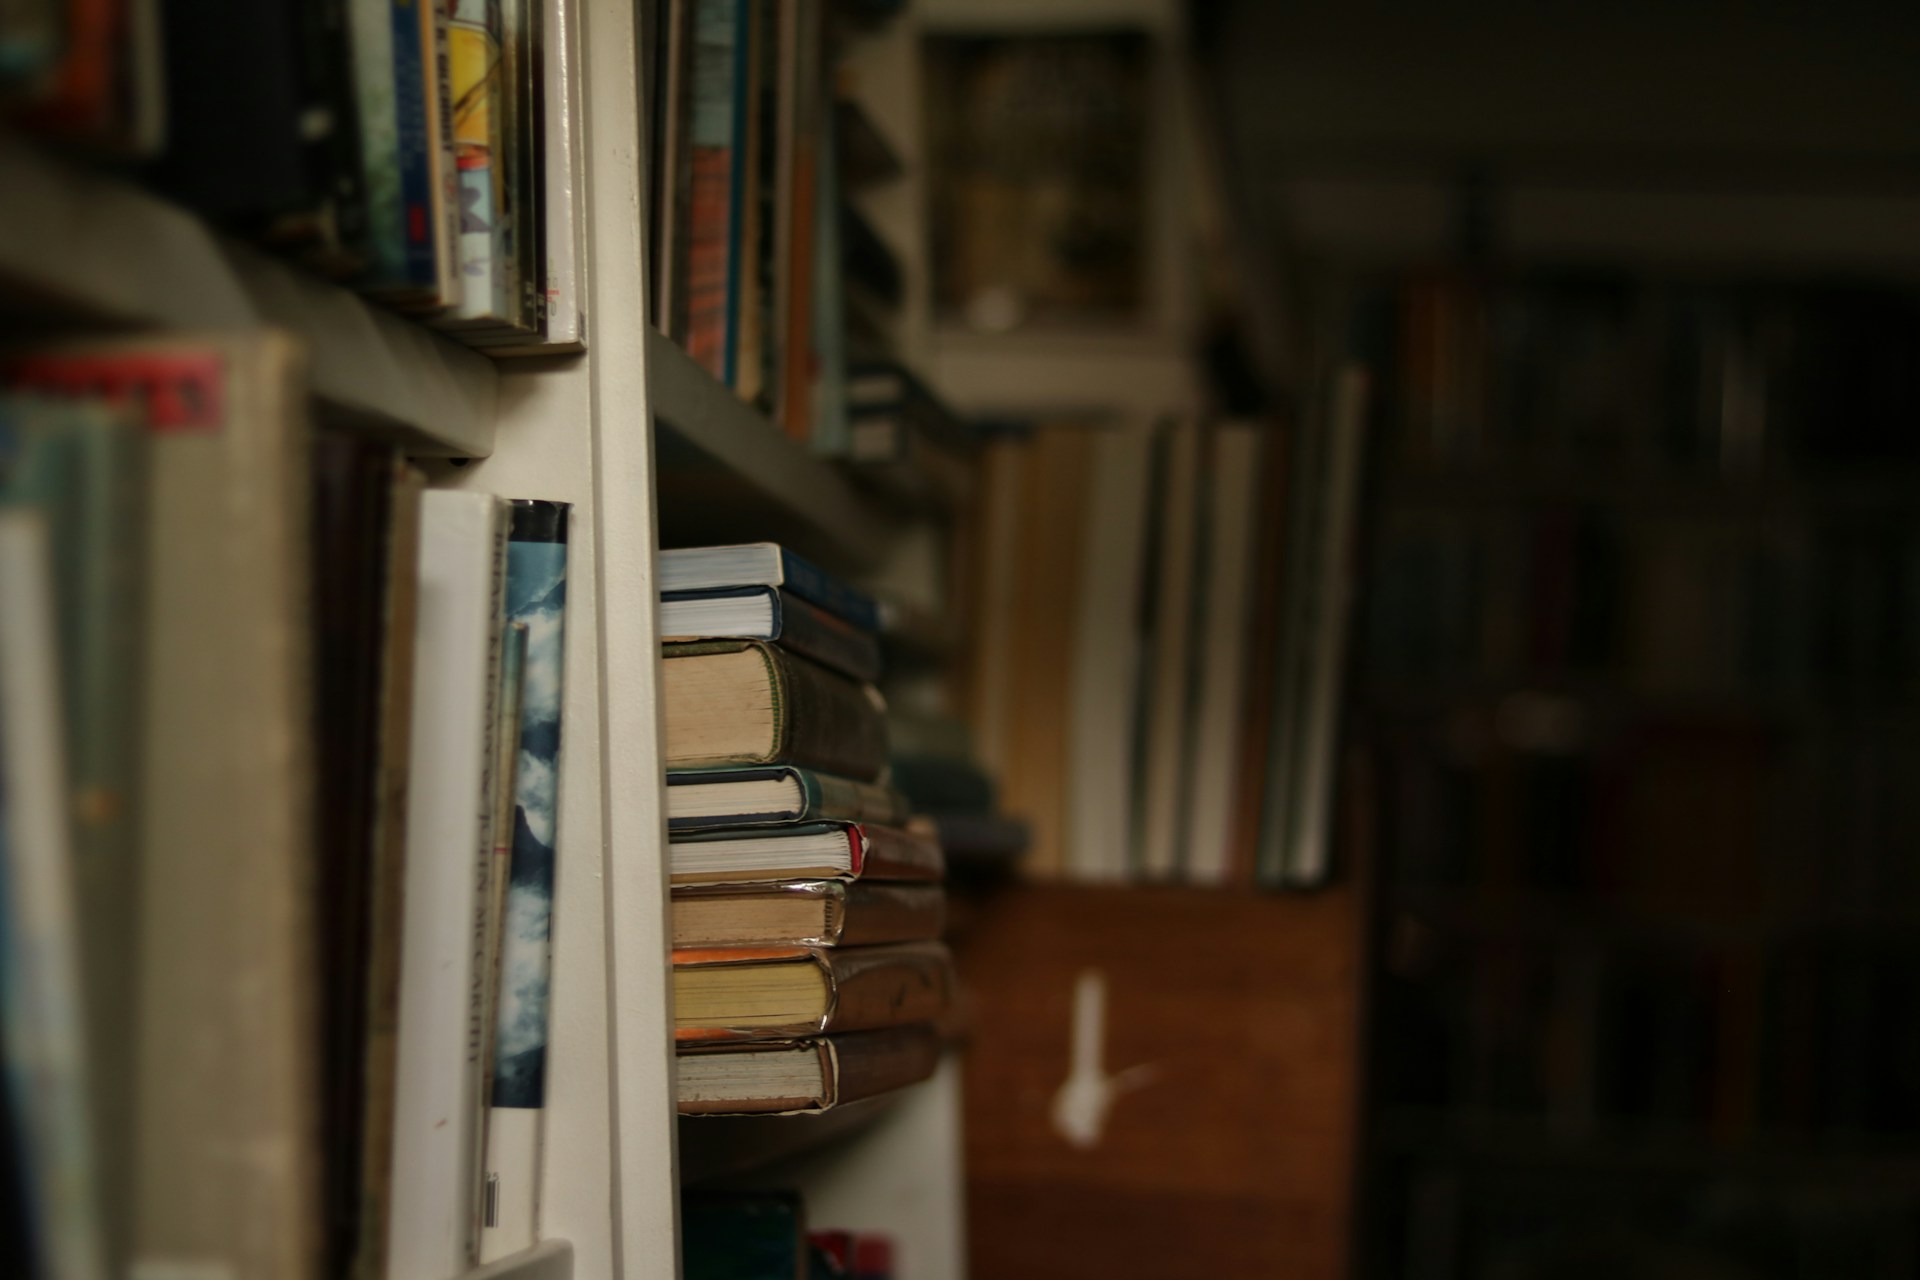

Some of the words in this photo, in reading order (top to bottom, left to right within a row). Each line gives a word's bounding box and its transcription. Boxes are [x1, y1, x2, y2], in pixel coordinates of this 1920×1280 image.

[491, 534, 503, 621] BRIAN
[485, 636, 498, 755] KEENAN
[477, 814, 492, 892] JOHN
